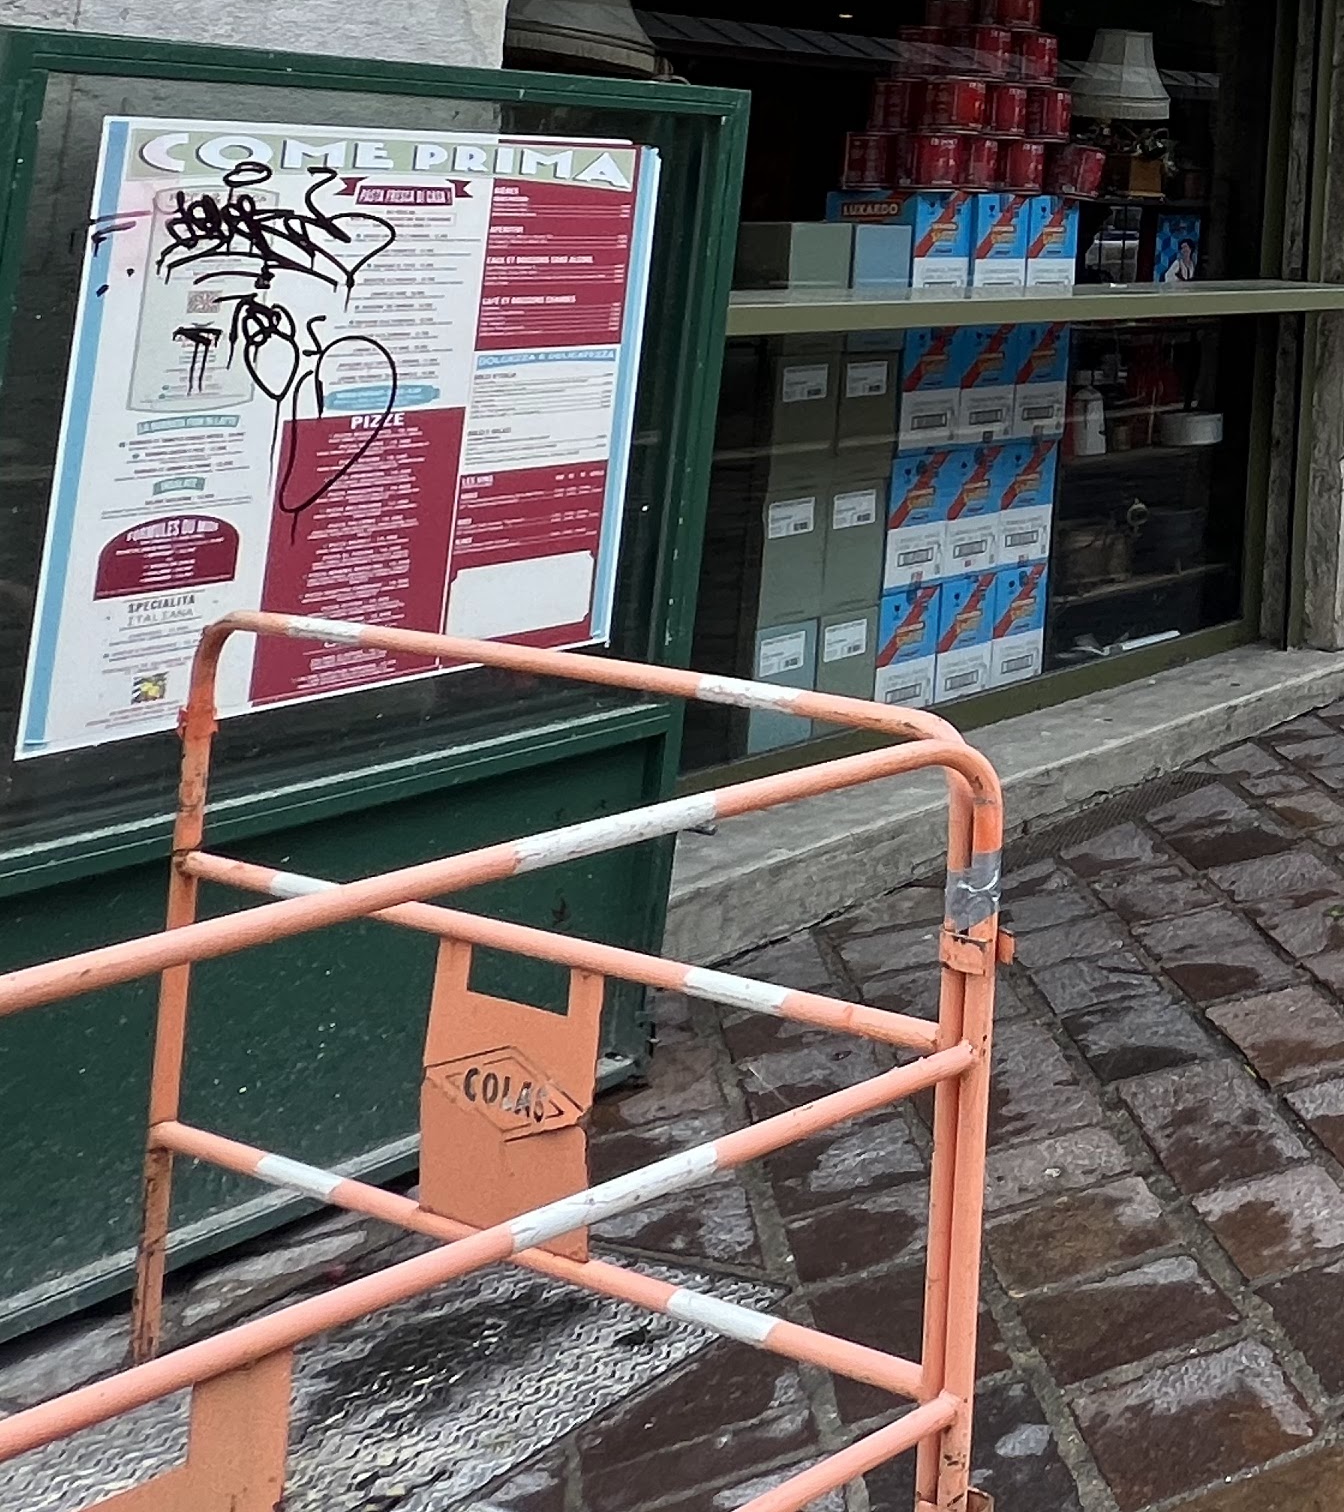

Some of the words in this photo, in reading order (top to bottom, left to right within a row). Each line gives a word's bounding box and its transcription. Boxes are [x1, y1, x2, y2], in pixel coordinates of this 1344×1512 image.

[139, 132, 395, 172] COME
[412, 144, 632, 188] PRIMA
[842, 202, 899, 217] LUXARDO
[350, 412, 405, 429] PIZZE
[463, 1067, 548, 1123] COLAS
